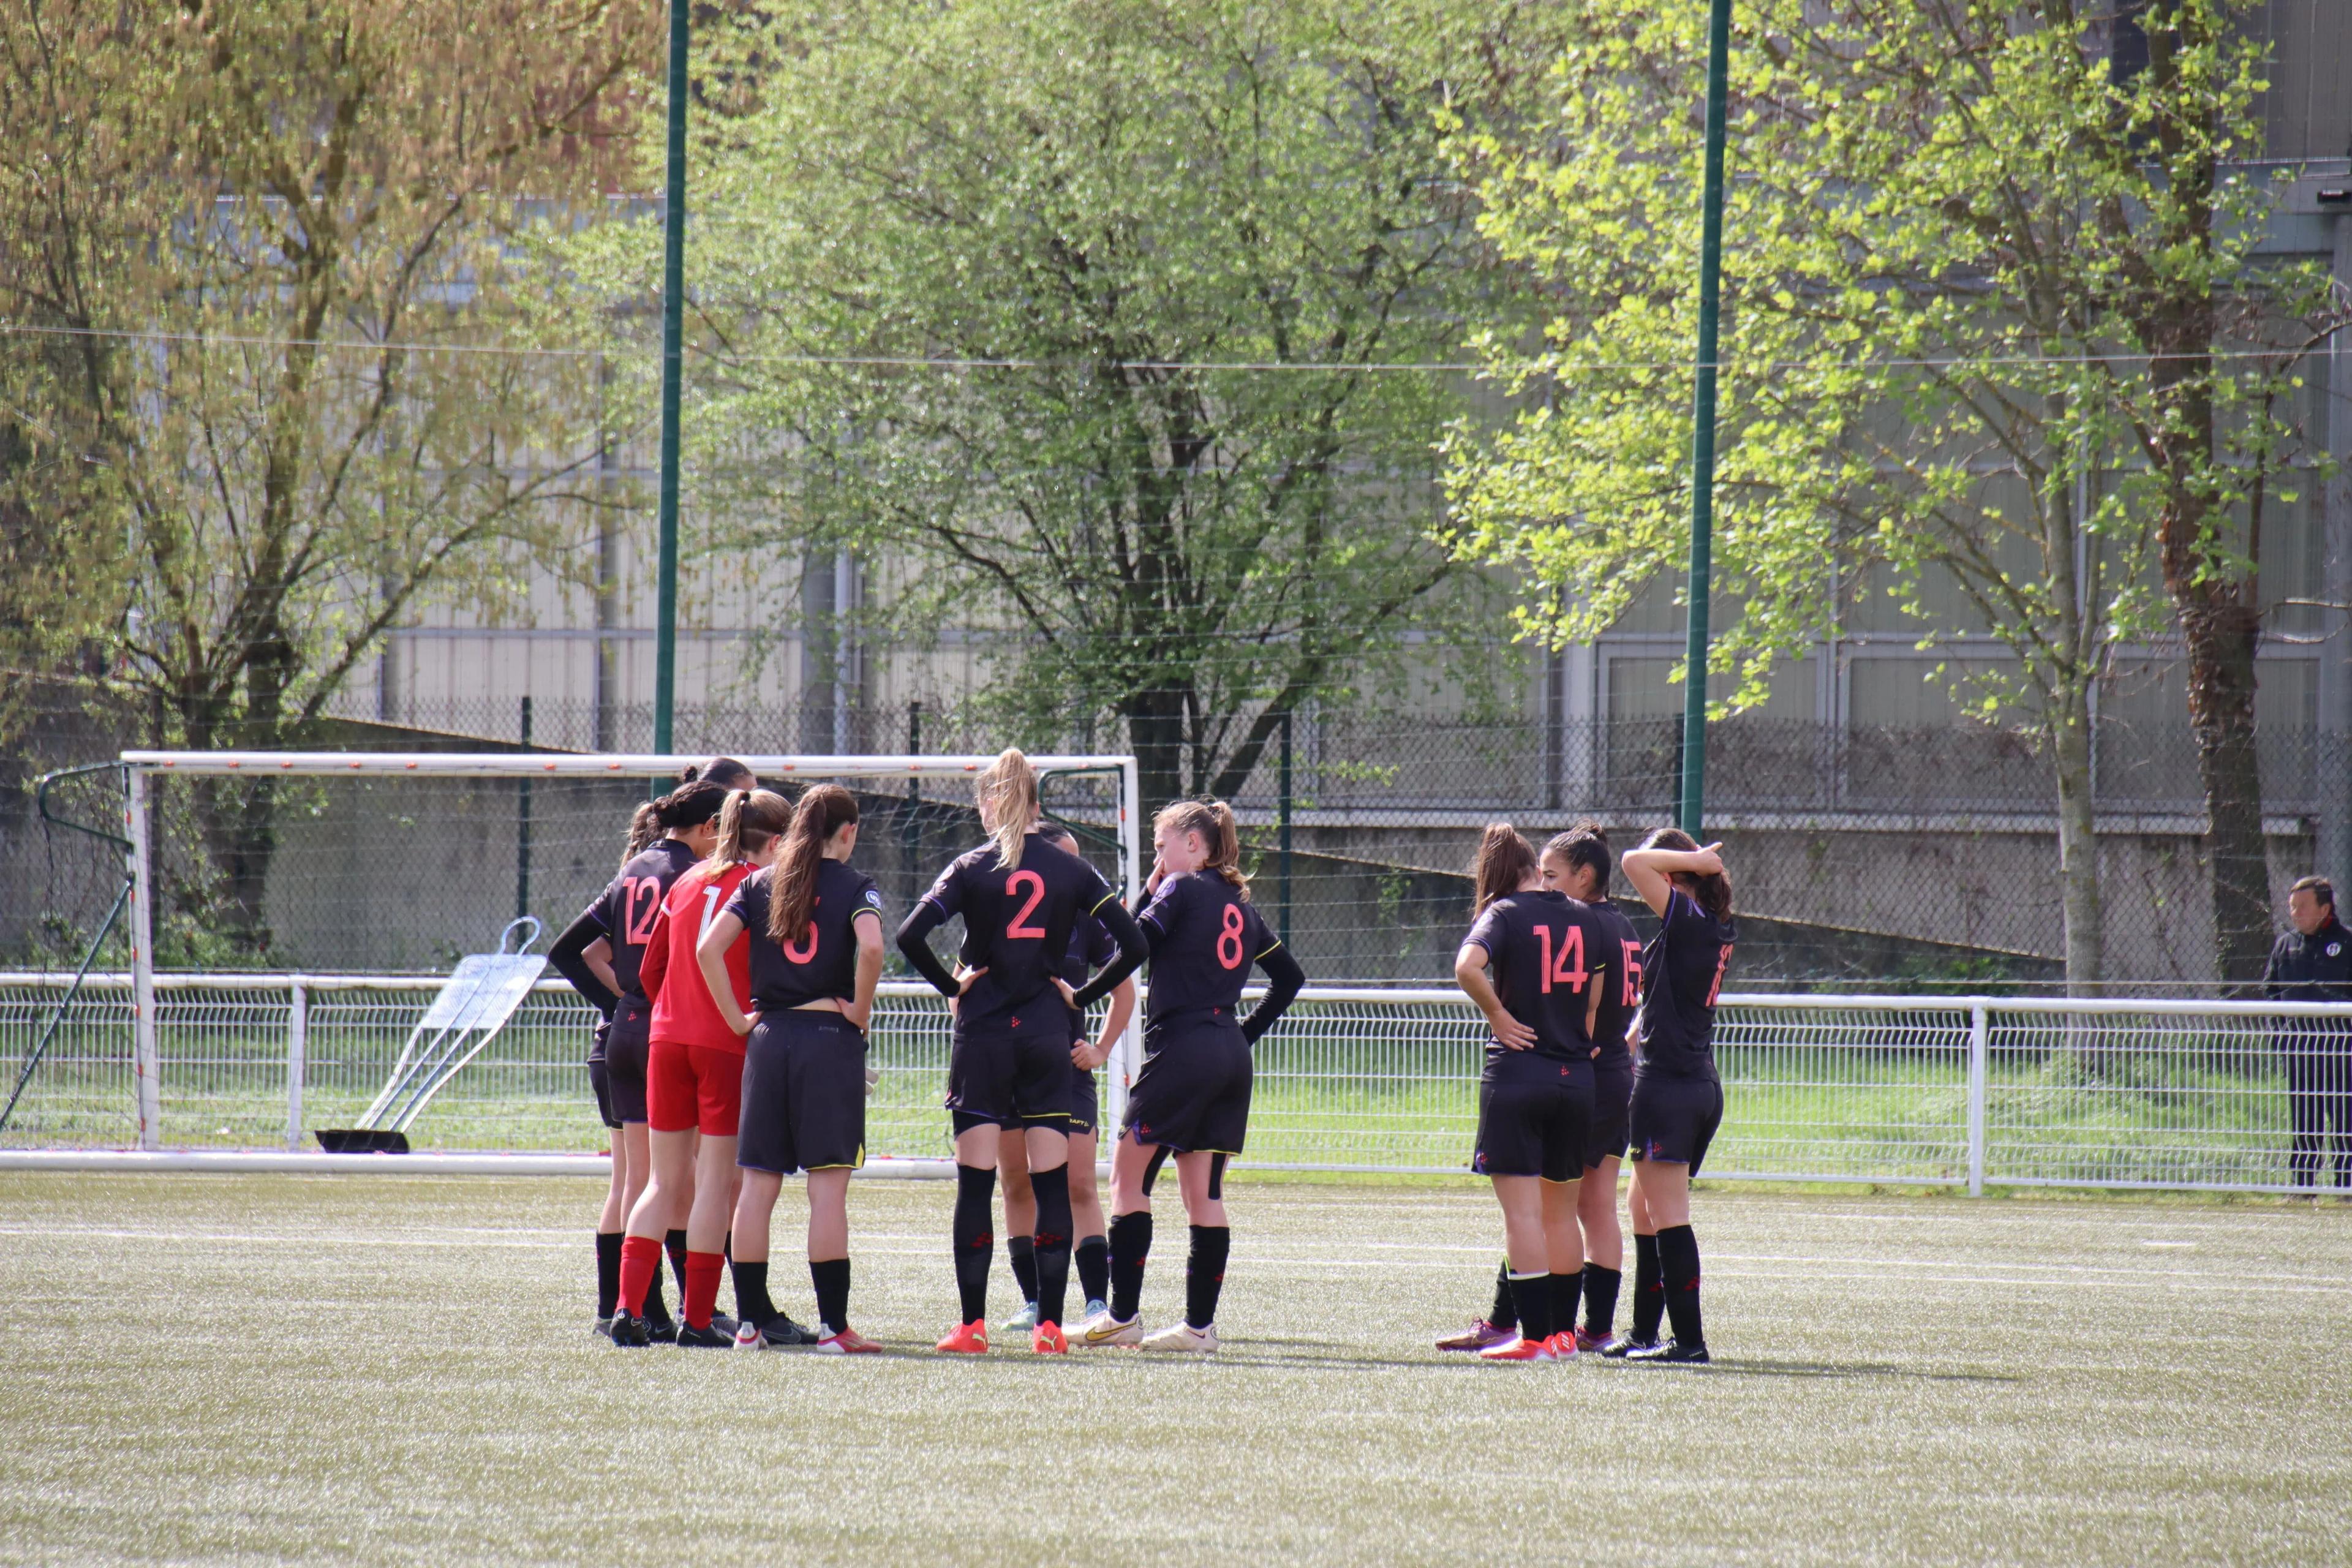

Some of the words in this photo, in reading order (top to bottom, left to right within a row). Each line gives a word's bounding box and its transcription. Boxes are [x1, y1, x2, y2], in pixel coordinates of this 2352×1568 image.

[622, 876, 660, 944] 12
[696, 886, 722, 950] 1
[1006, 870, 1045, 939] 2
[1217, 903, 1244, 970] 8
[1533, 925, 1589, 993] 14
[1620, 938, 1642, 1006] 15
